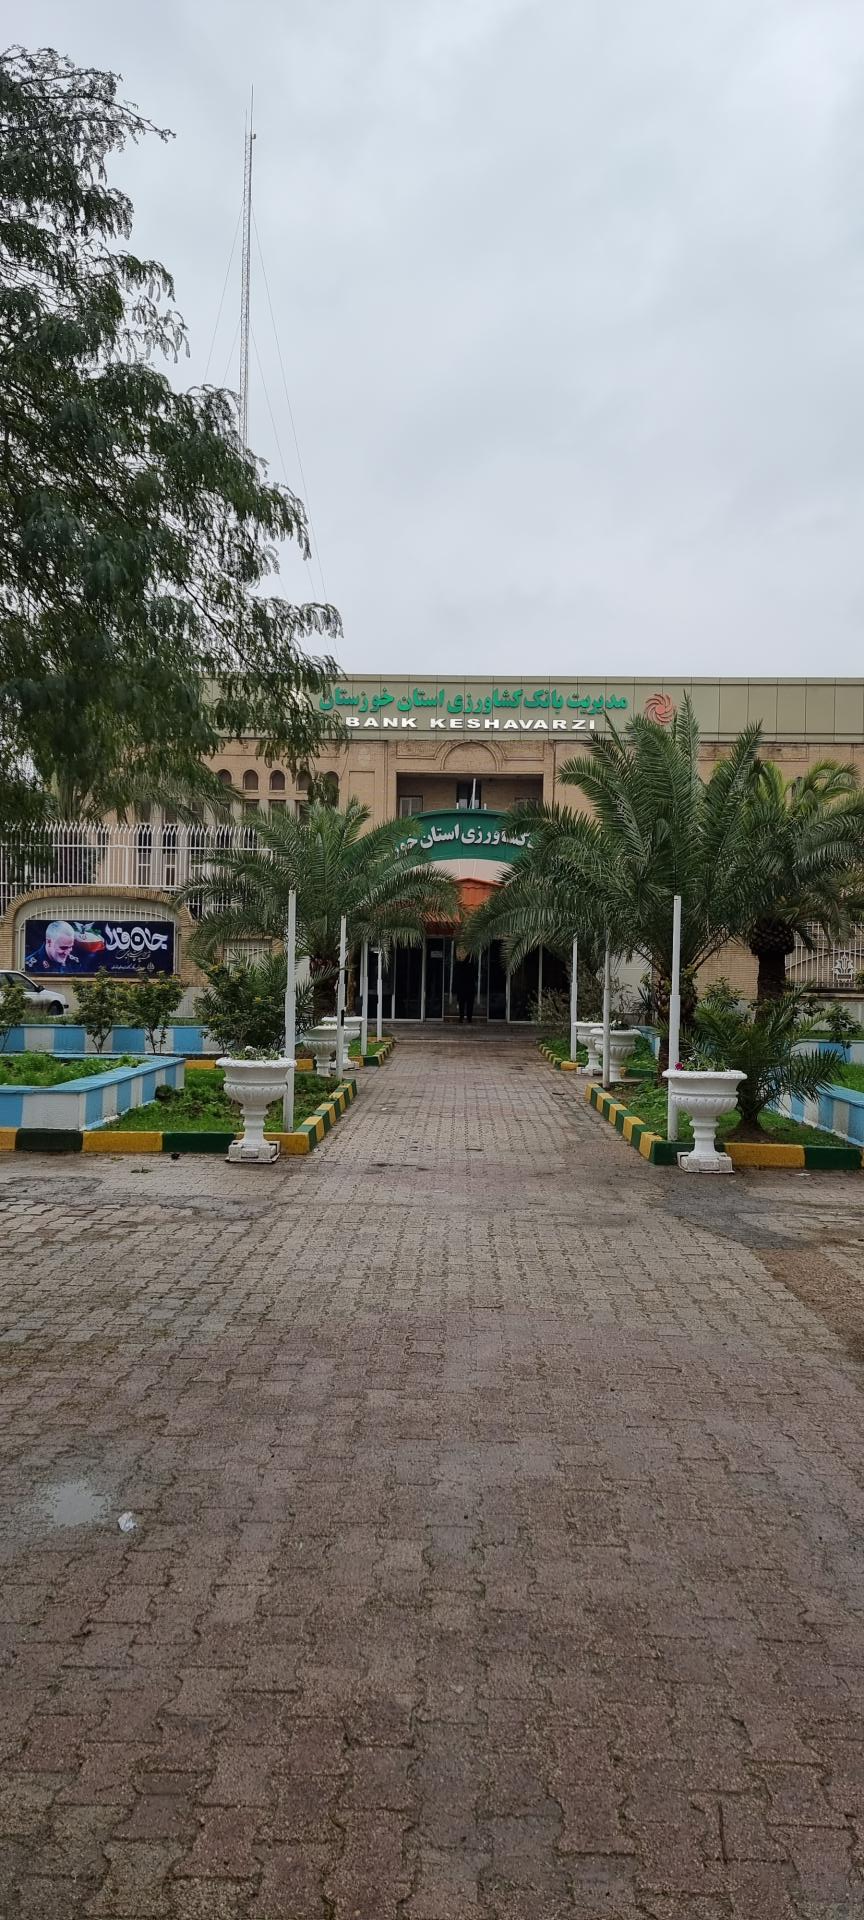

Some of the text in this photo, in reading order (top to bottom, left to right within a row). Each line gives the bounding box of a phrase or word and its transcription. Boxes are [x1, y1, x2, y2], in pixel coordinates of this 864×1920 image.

[319, 687, 628, 715] مدیریت بانک کشاورزی استان خوزستان
[345, 716, 596, 730] BANK KESHAVARZI
[420, 823, 460, 849] استان
[130, 926, 168, 951] جان
